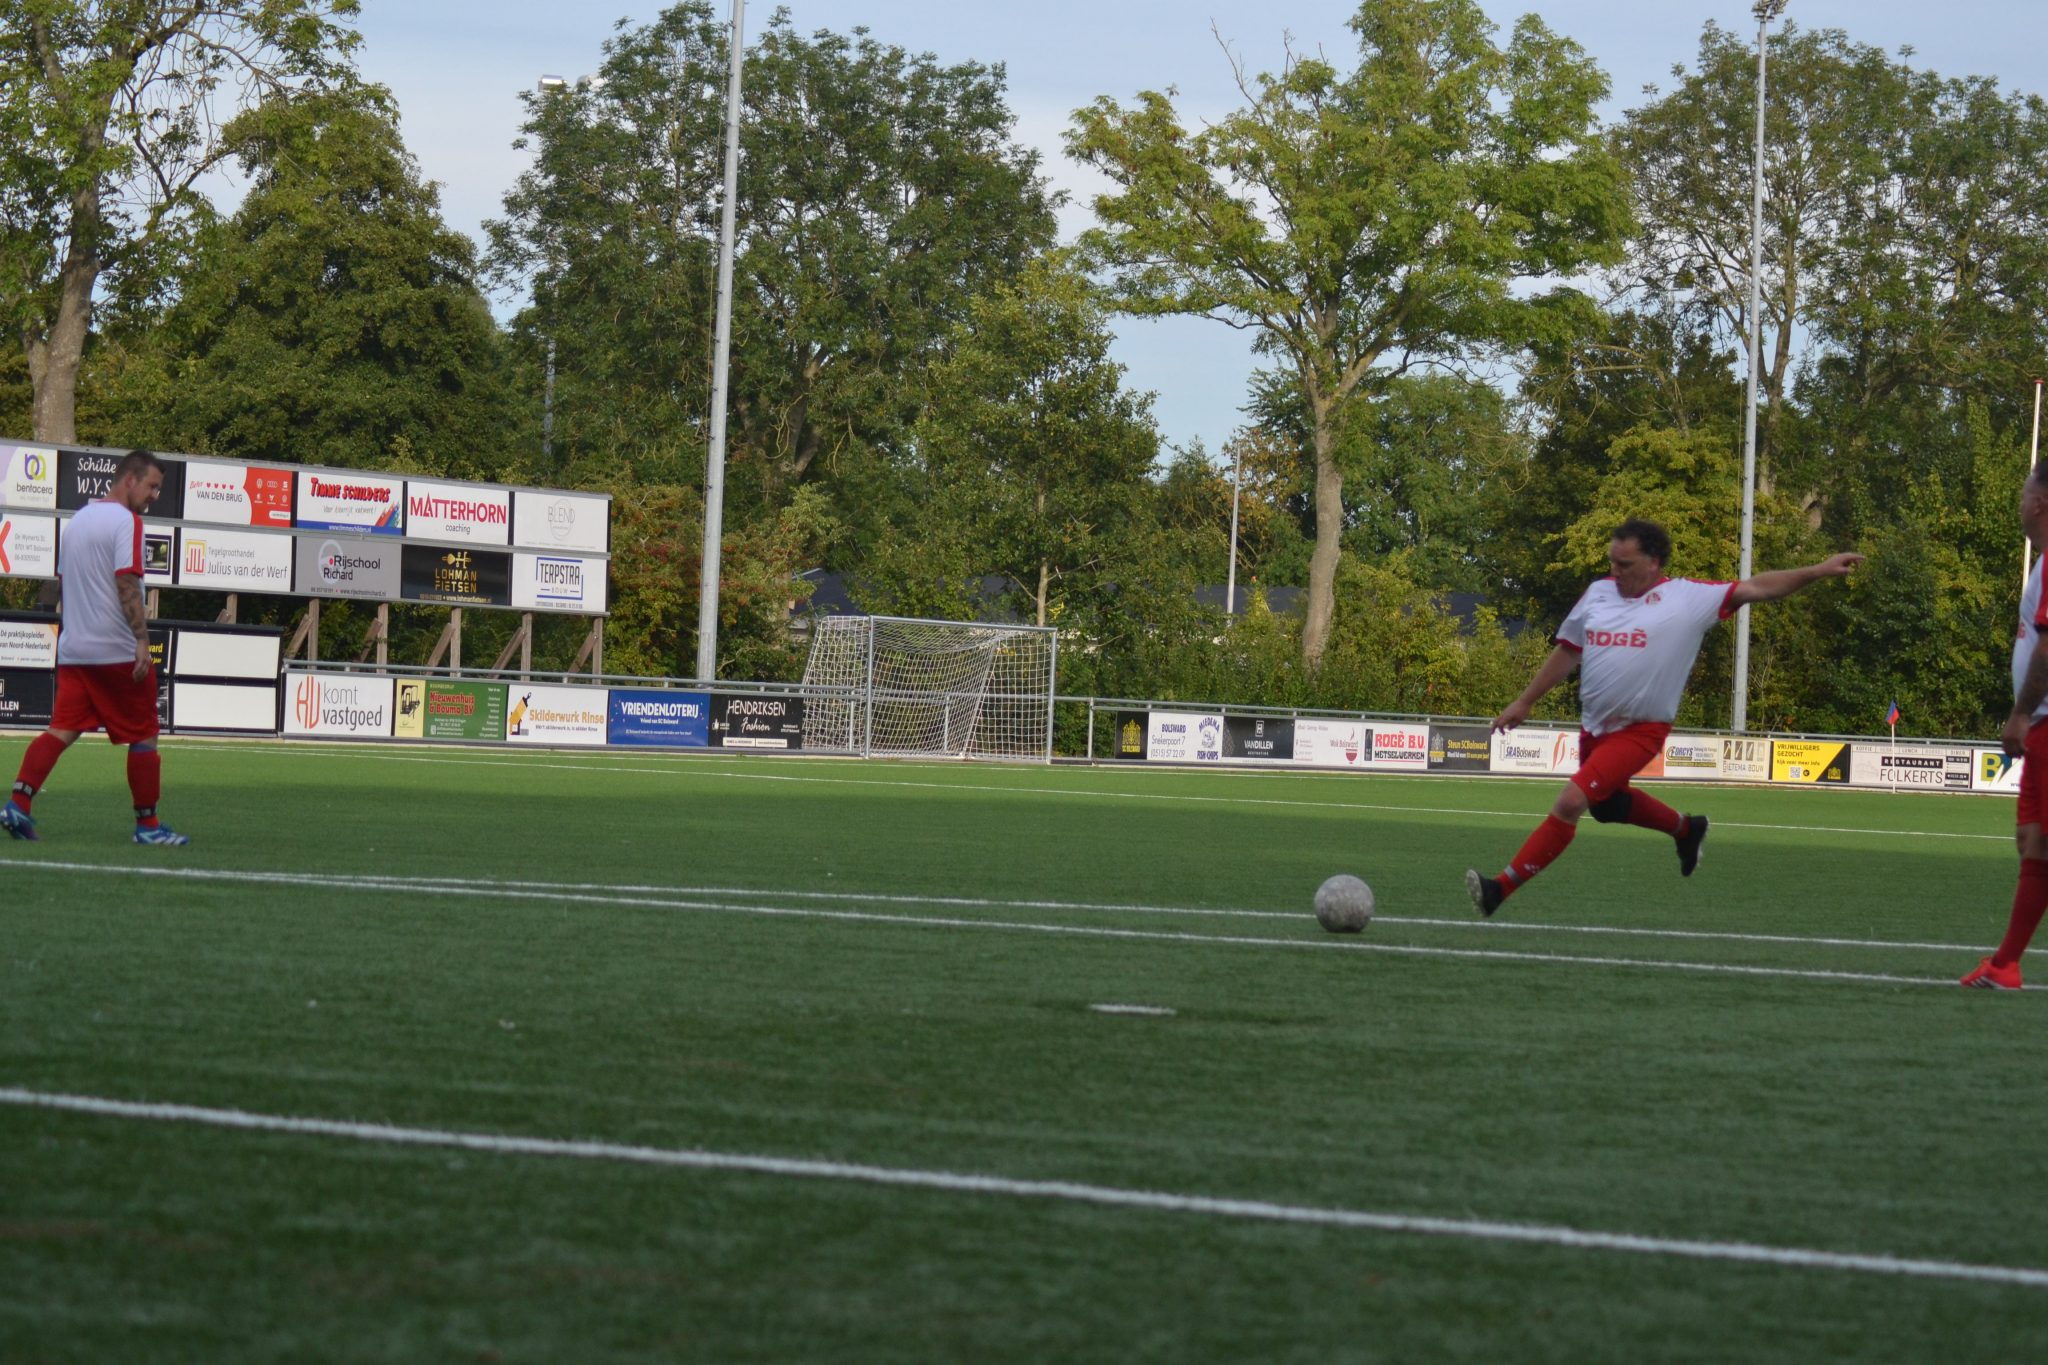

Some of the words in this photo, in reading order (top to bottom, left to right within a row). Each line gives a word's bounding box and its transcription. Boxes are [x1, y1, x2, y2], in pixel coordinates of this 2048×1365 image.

[196, 490, 210, 500] VAN
[211, 491, 225, 501] DEN
[226, 492, 243, 503] BRUG
[311, 477, 342, 500] TIMME
[342, 484, 391, 505] SCHILDERS
[410, 492, 507, 525] MATTERHORN
[445, 522, 471, 536] coaching
[207, 546, 256, 560] Tegelgroothandel
[207, 561, 232, 577] Julius
[233, 565, 249, 577] van
[250, 563, 266, 578] der
[267, 564, 288, 580] Werf
[333, 555, 381, 571] Rijschool
[323, 567, 354, 581] Richard
[435, 567, 478, 582] LOHMAN
[540, 563, 581, 586] TERPSTRA
[434, 580, 478, 594] FIETSEN
[323, 681, 359, 706] komt
[430, 691, 475, 705] Nieuwenhuis
[621, 701, 699, 719] VRIENDENLOTERIJ
[727, 699, 786, 717] HENDRIKSEN
[322, 704, 383, 732] vastgoed
[529, 708, 580, 725] Skilderwurk
[581, 711, 605, 726] Rinse
[740, 716, 771, 734] Fashion
[1161, 723, 1187, 734] BOLSWARD
[1374, 750, 1425, 761] METSELWERKEN
[1777, 743, 1821, 752] VRIJWILLIGERS
[1777, 750, 1804, 758] GEZOCHT
[1879, 768, 1943, 784] FOLKERTS
